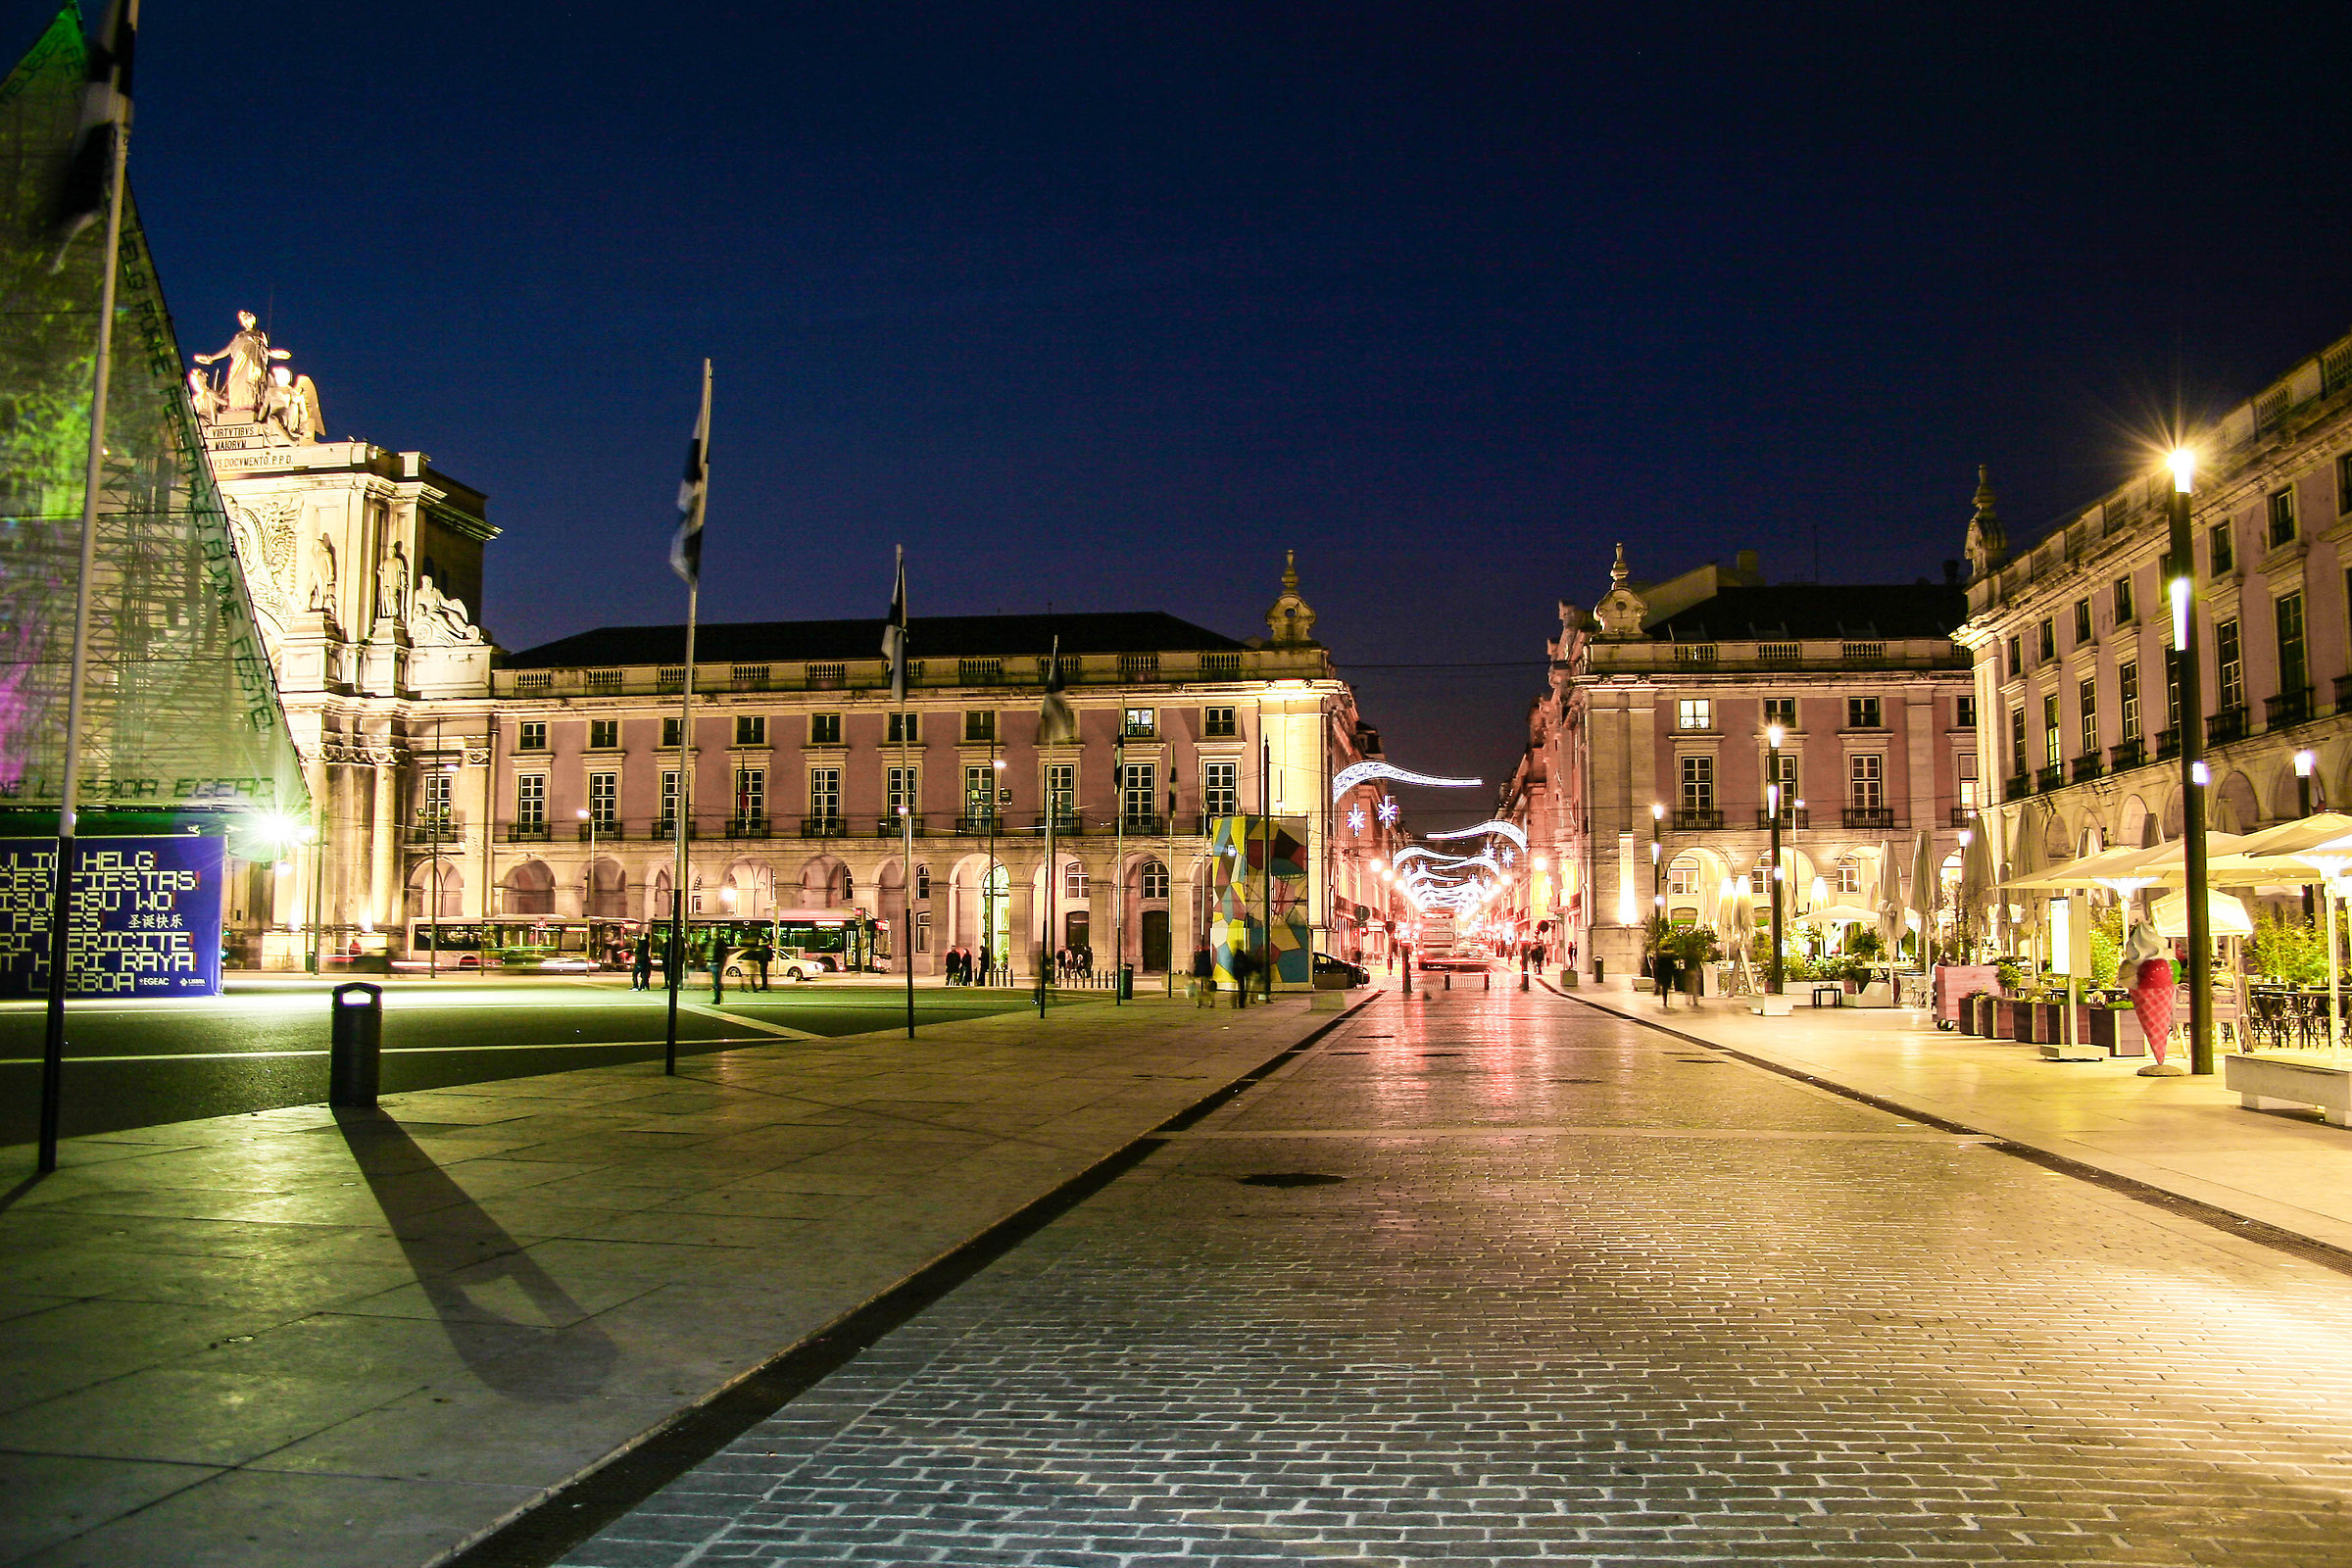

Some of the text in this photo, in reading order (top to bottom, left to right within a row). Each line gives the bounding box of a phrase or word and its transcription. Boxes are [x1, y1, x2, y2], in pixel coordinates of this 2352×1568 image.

[127, 913, 184, 929] 圣诞快乐
[34, 953, 106, 972] HRI
[27, 972, 135, 992] LSBOA
[143, 977, 170, 986] EGEAC
